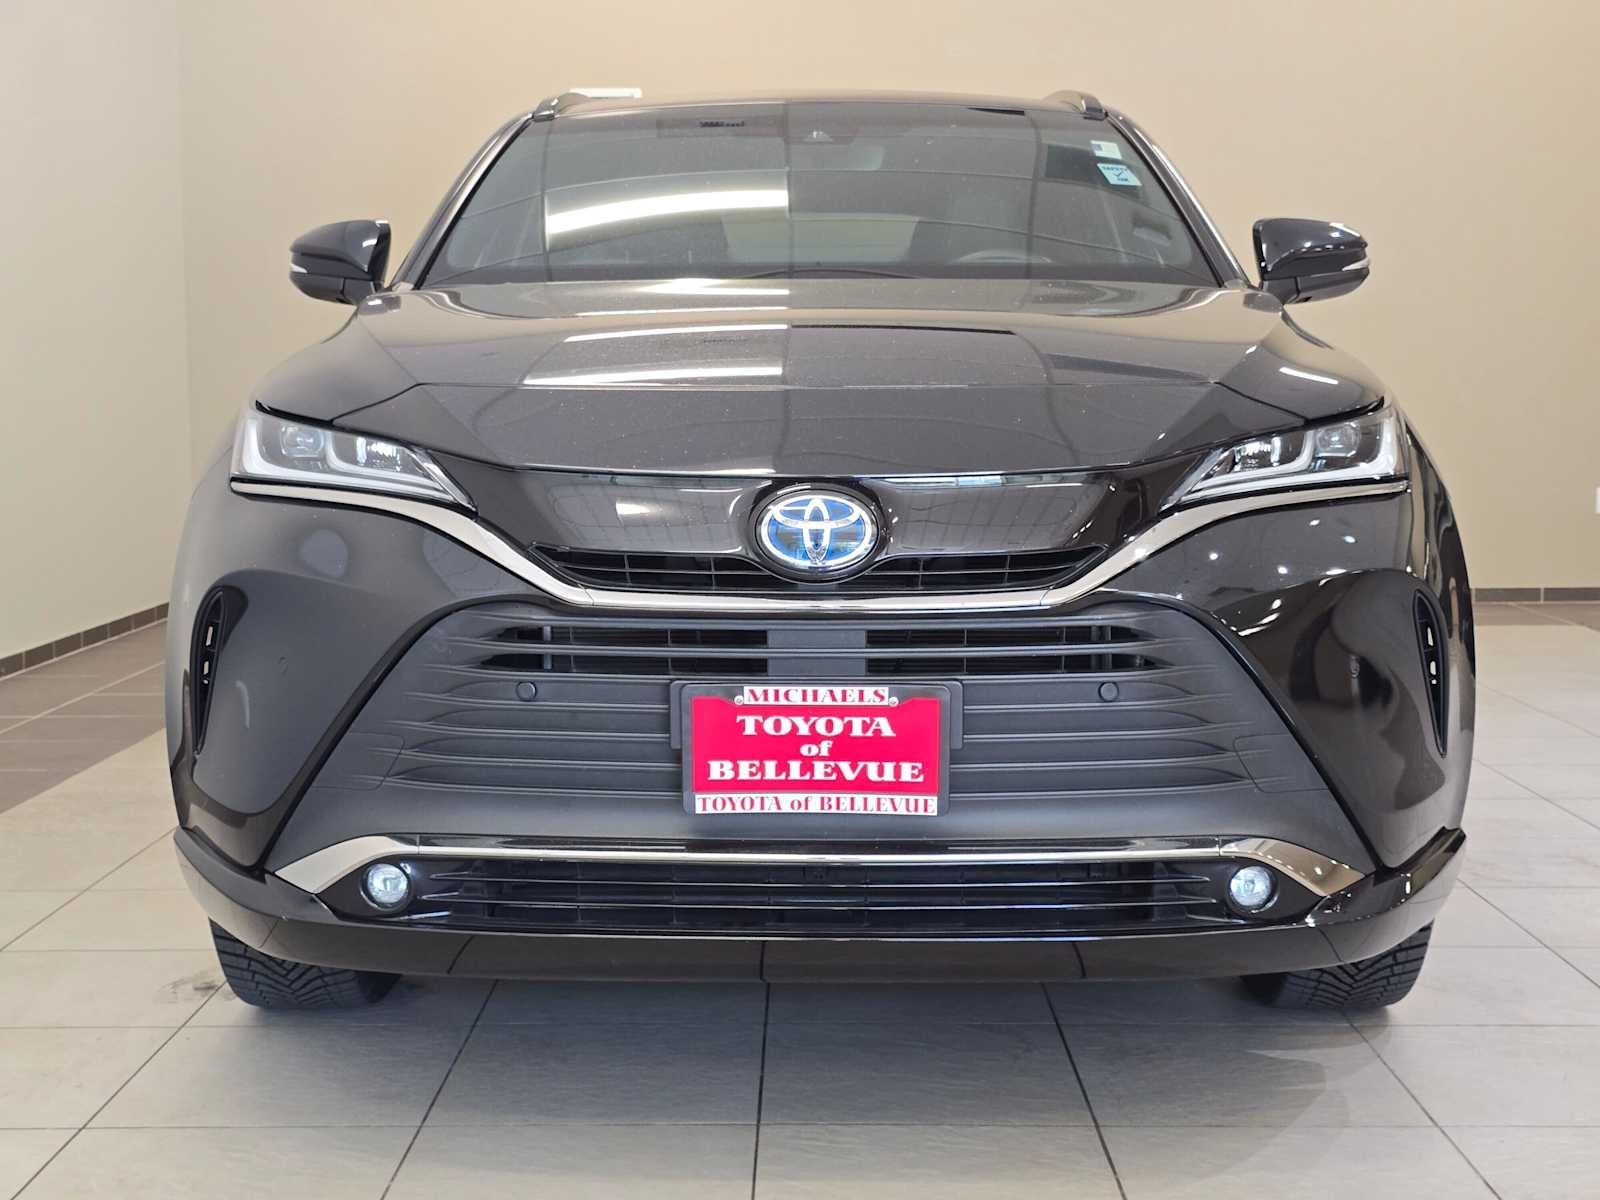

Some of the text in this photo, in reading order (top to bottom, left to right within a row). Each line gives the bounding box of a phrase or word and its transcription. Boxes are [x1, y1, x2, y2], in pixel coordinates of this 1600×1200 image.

[748, 688, 886, 703] MICHAELS
[736, 715, 896, 737] TOYOTA
[800, 740, 832, 757] of
[707, 760, 925, 782] BELLEVUE
[698, 796, 936, 813] TOYOTA of BELLEVUE
